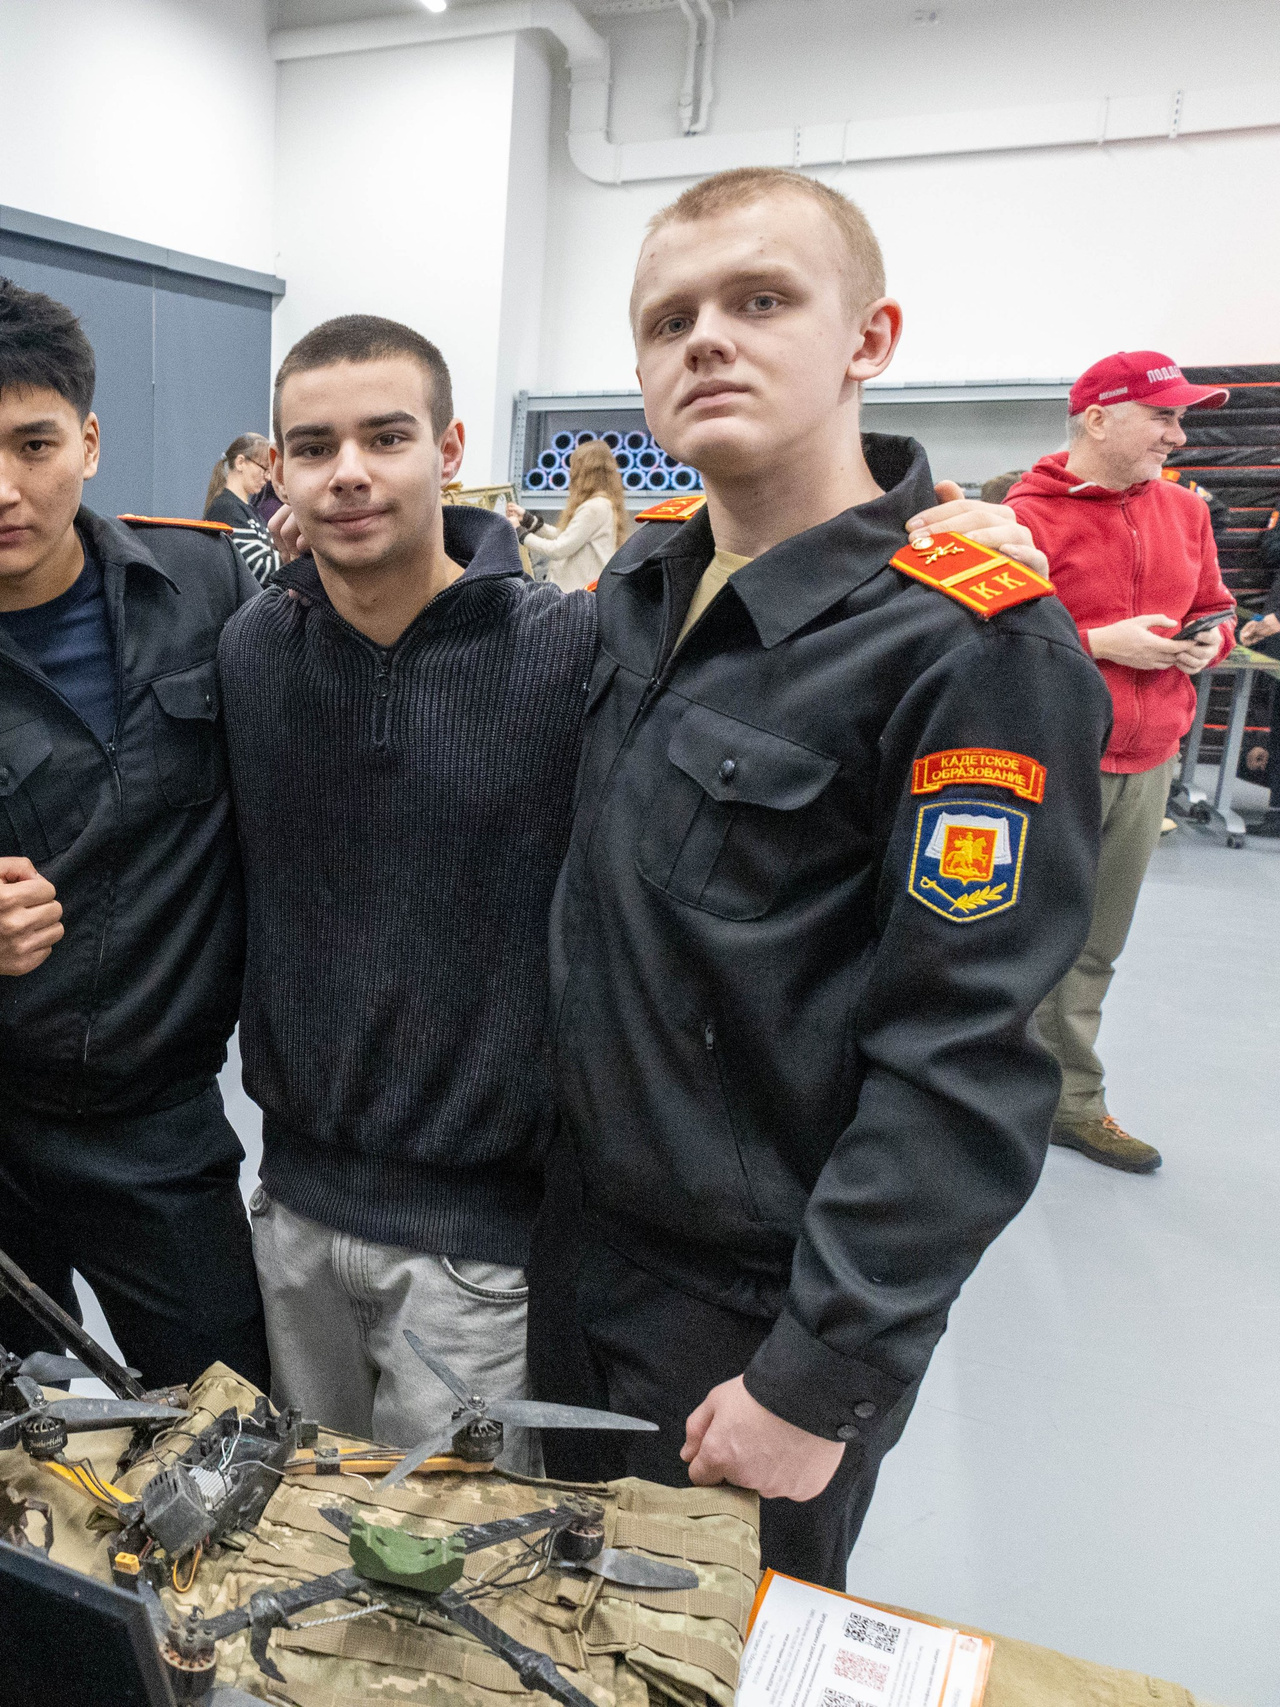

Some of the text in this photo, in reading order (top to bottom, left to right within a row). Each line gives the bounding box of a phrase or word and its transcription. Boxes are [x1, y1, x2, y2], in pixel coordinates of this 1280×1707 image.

[968, 571, 1027, 600] КК
[940, 754, 1020, 771] КАДЕТСКОЕ
[931, 766, 1027, 787] ОБРАЗОВАНИЕ
